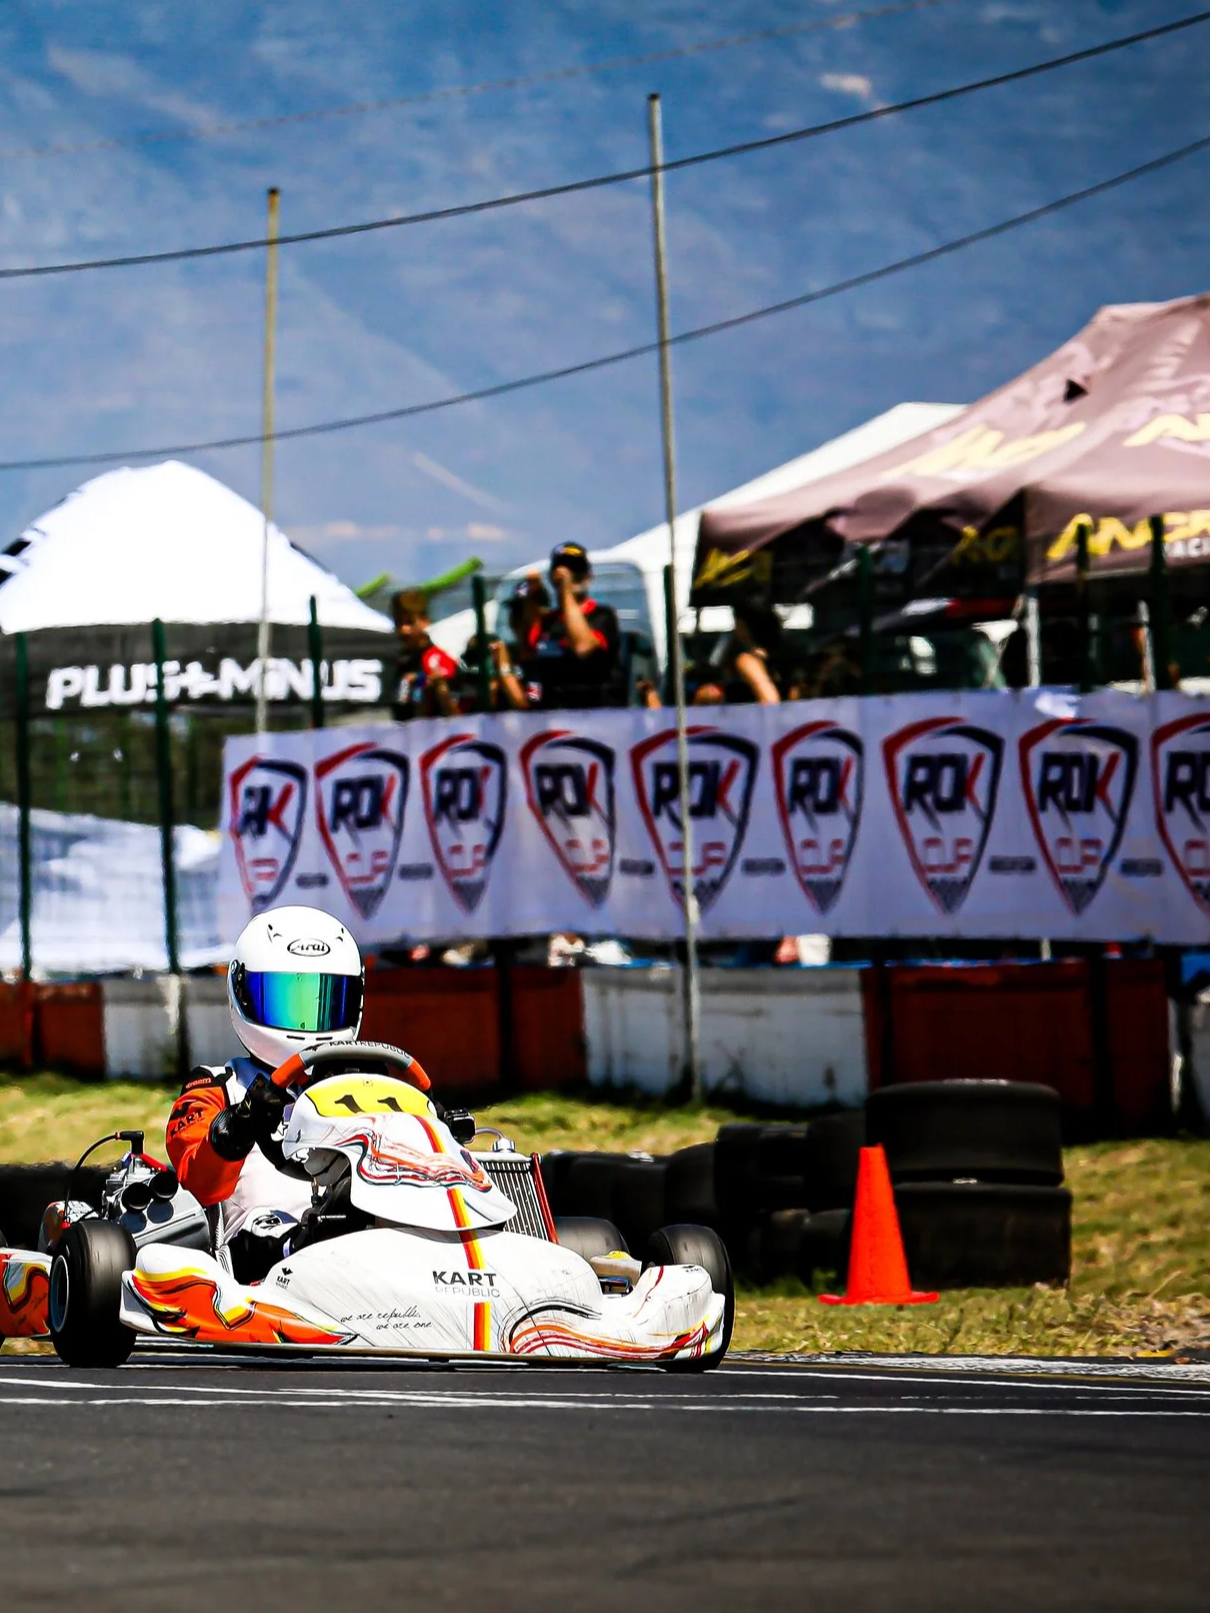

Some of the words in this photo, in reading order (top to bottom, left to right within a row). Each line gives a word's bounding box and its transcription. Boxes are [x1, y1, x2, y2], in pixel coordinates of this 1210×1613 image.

[788, 755, 854, 828] ROK
[904, 752, 986, 830] ROK
[1038, 752, 1120, 830] ROK
[291, 942, 326, 953] Arai
[433, 1270, 497, 1287] KART
[413, 1321, 432, 1329] one
